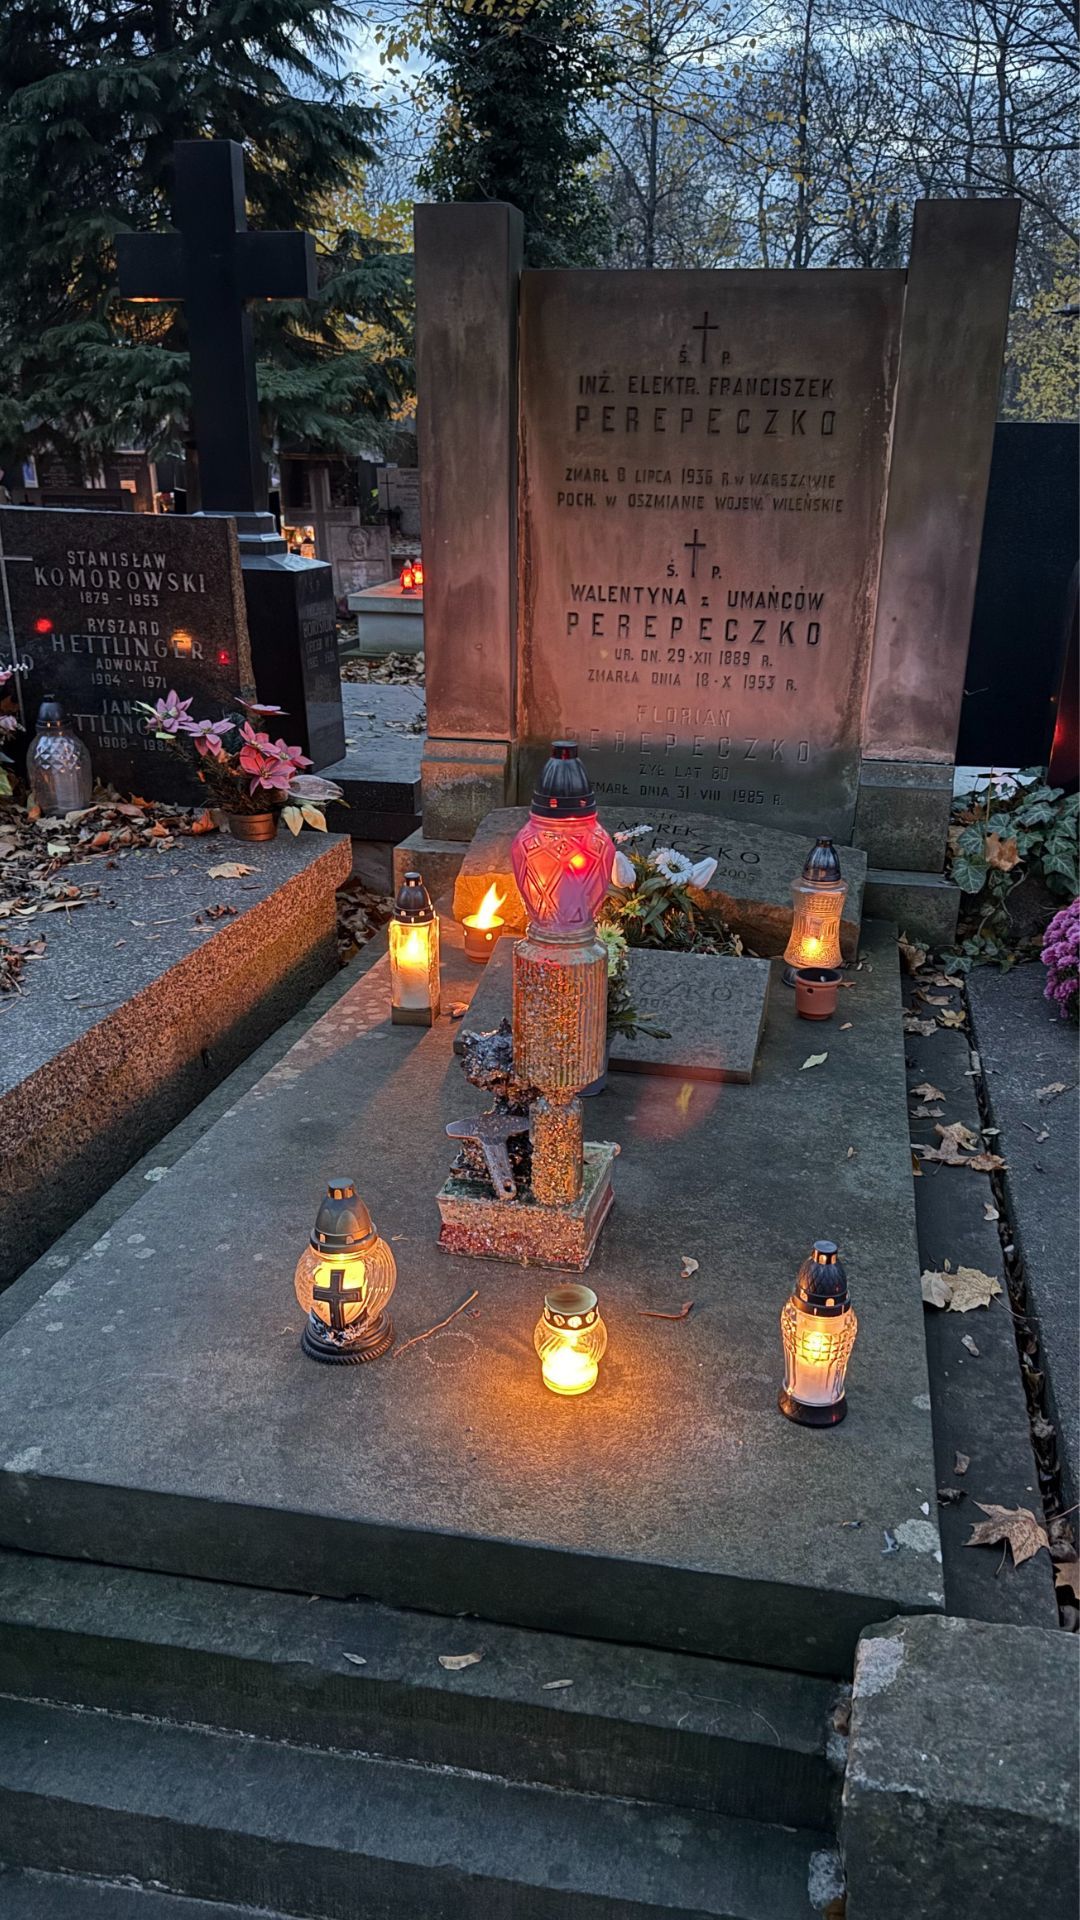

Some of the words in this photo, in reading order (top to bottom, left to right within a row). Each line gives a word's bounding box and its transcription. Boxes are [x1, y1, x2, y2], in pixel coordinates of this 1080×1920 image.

[578, 370, 615, 395] INŻ.
[628, 376, 700, 396] ELEKTR.
[709, 377, 833, 398] FRANCISZEK
[575, 405, 836, 436] PEREPECZKO
[565, 467, 609, 483] ZMARŁ
[617, 467, 626, 482] 8
[635, 470, 672, 485] LIPCA
[750, 474, 836, 489] WARSZAWIE
[557, 492, 596, 507] POCH.
[627, 493, 705, 510] OSZMIANIE
[772, 492, 843, 513] WILEŃSKIE
[67, 550, 167, 570] STANISŁAW
[34, 566, 206, 593] KOMOROWSKI
[711, 565, 722, 580] P.
[79, 591, 110, 605] 1879
[128, 594, 160, 607] 1953
[570, 583, 687, 606] WALENTYNA
[727, 584, 825, 611] UMAŃCÓW
[87, 618, 160, 636] RYSZARD
[566, 611, 821, 646] PEREPECZKO
[51, 633, 205, 660] HETTLINGER
[95, 660, 159, 673] ADWOKAT
[614, 648, 634, 661] UR.
[640, 650, 662, 663] DN.
[719, 651, 750, 666] 1889
[91, 673, 121, 687] 1904
[141, 676, 167, 689] 1971
[587, 669, 640, 684] ZMARŁA
[651, 671, 681, 686] DNIA
[743, 674, 776, 691] 1953
[636, 704, 731, 727] FLORIAN
[97, 735, 128, 749] 1908
[564, 726, 811, 765] PEREPECZKO
[674, 765, 700, 780] LAT
[711, 766, 730, 782] 80
[639, 785, 670, 799] DNIA
[732, 788, 764, 805] 1985
[617, 820, 701, 838] MREK
